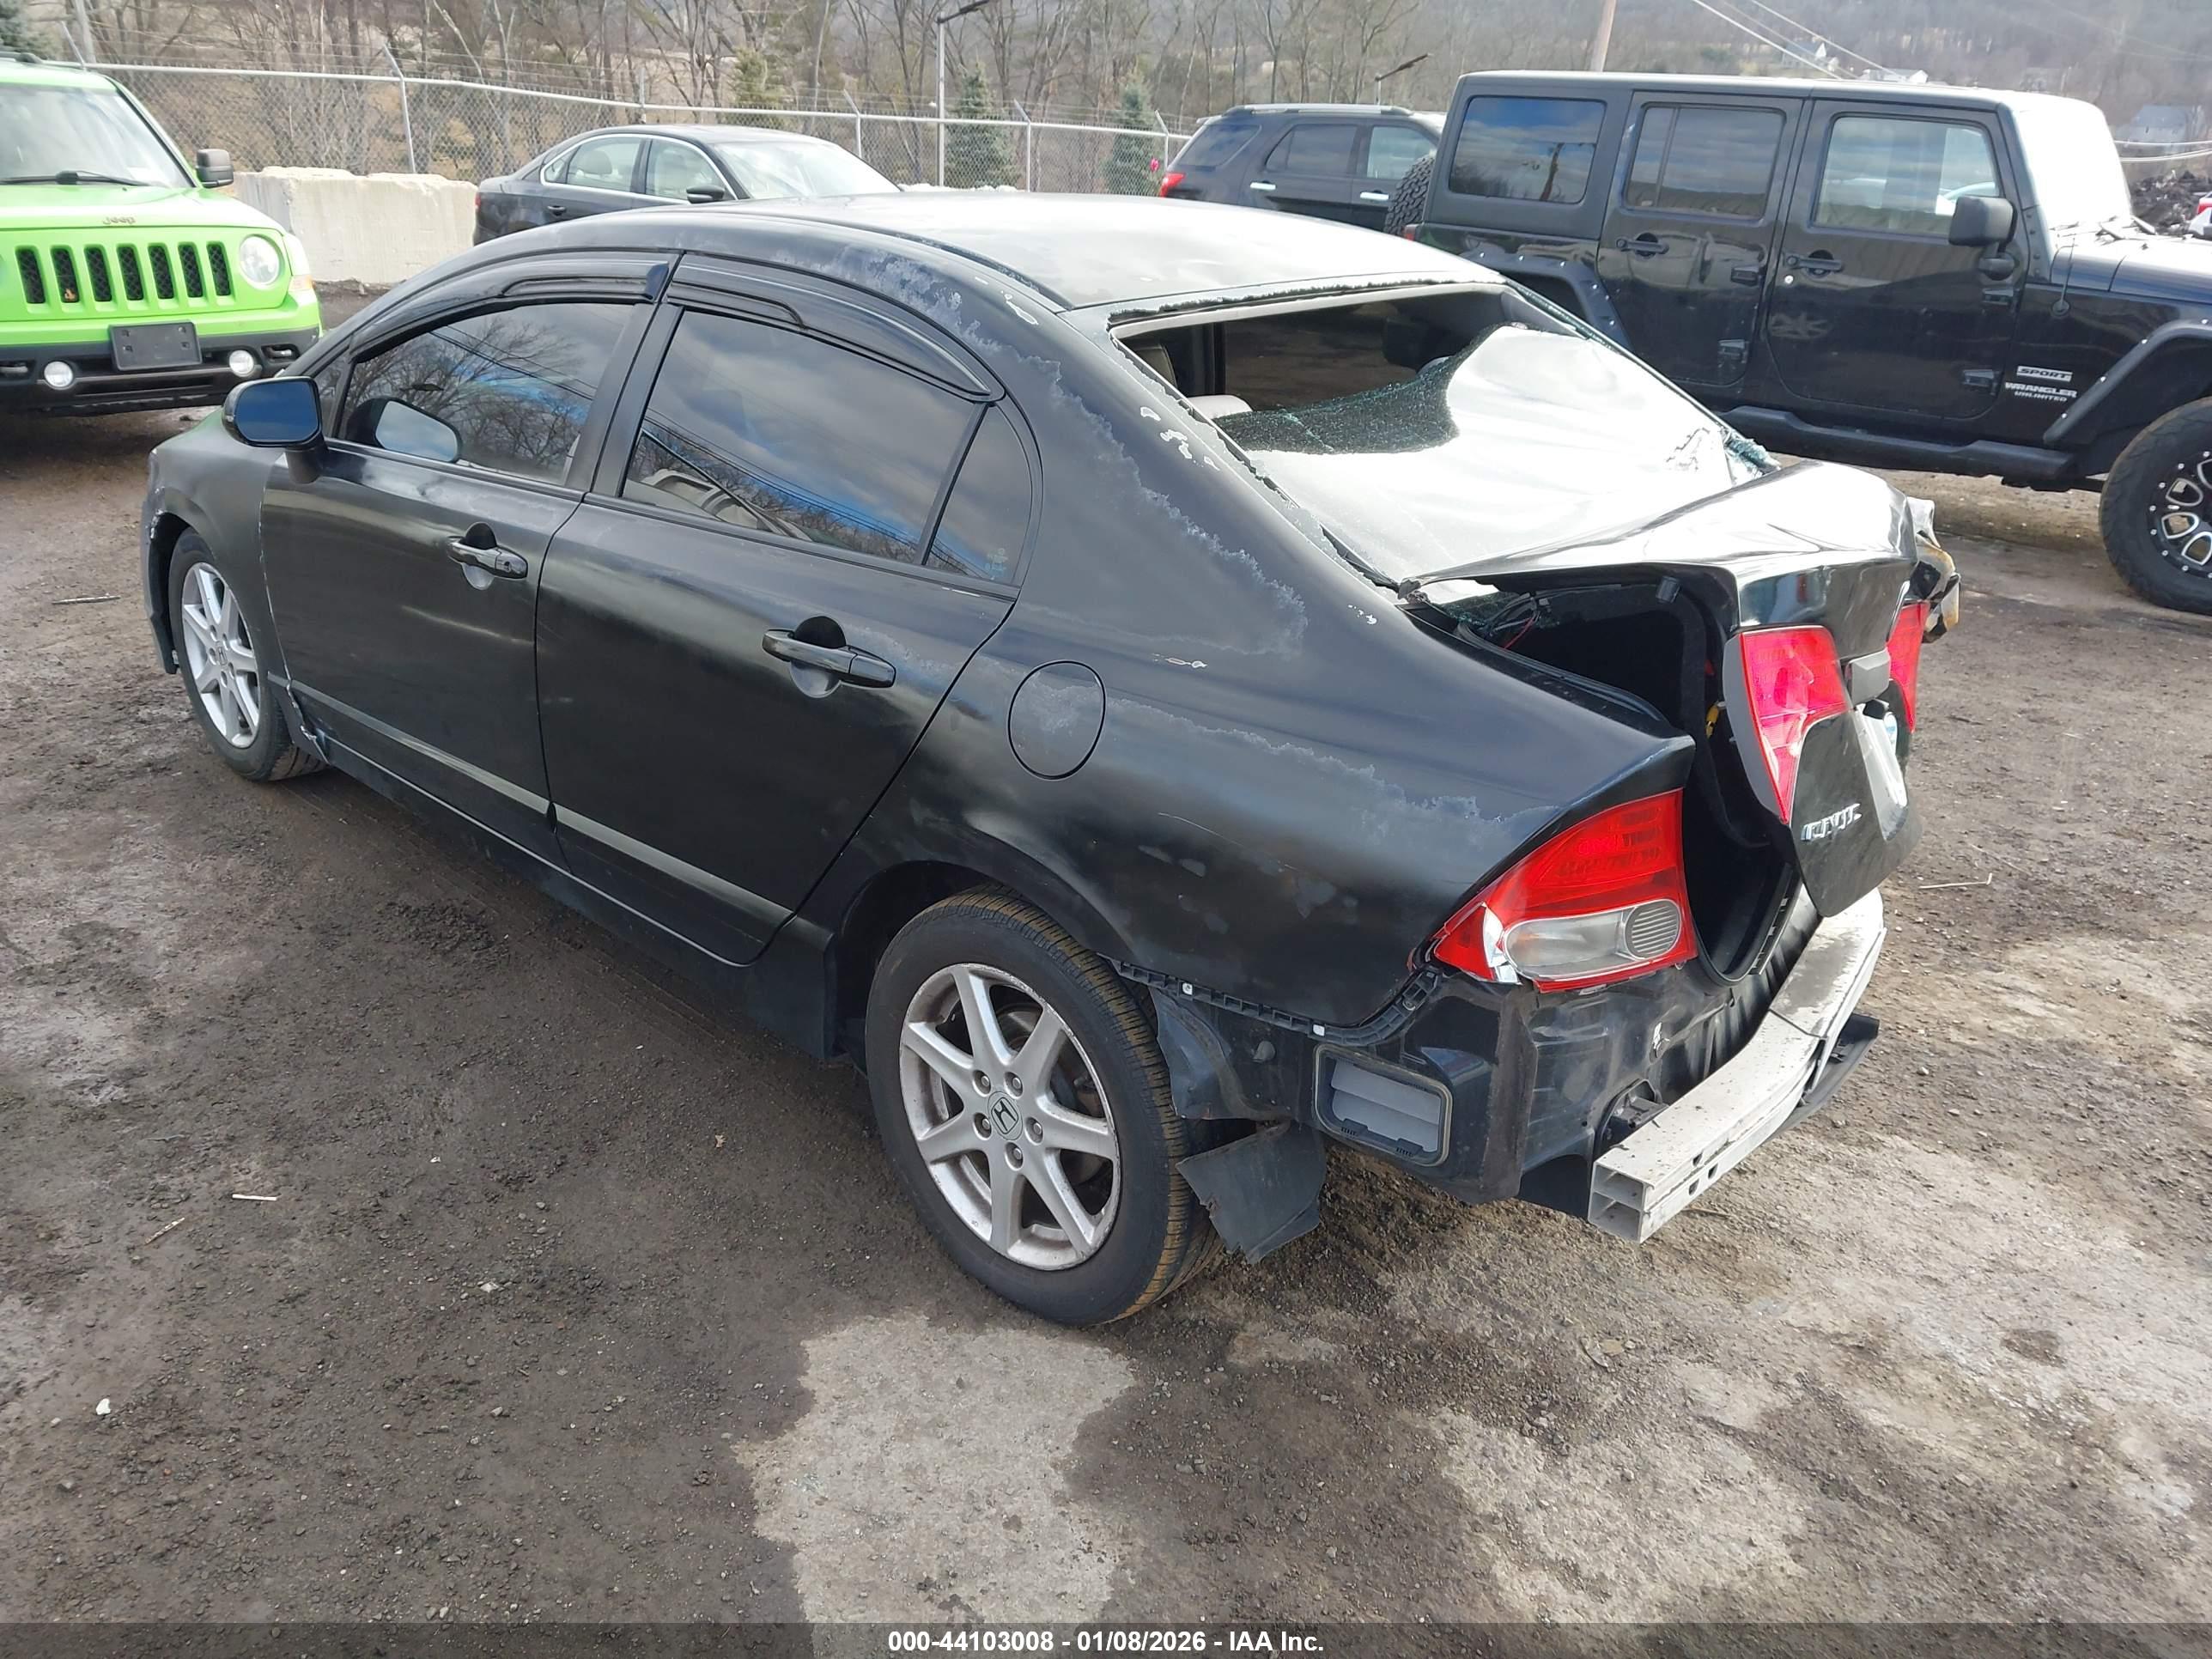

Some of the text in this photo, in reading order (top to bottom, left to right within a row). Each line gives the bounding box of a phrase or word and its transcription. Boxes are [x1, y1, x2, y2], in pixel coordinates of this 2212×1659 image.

[102, 216, 137, 225] Jeep
[2019, 367, 2071, 380] SPORT
[2005, 381, 2078, 398] WRANGLER
[2014, 391, 2068, 402] UNLIMITED
